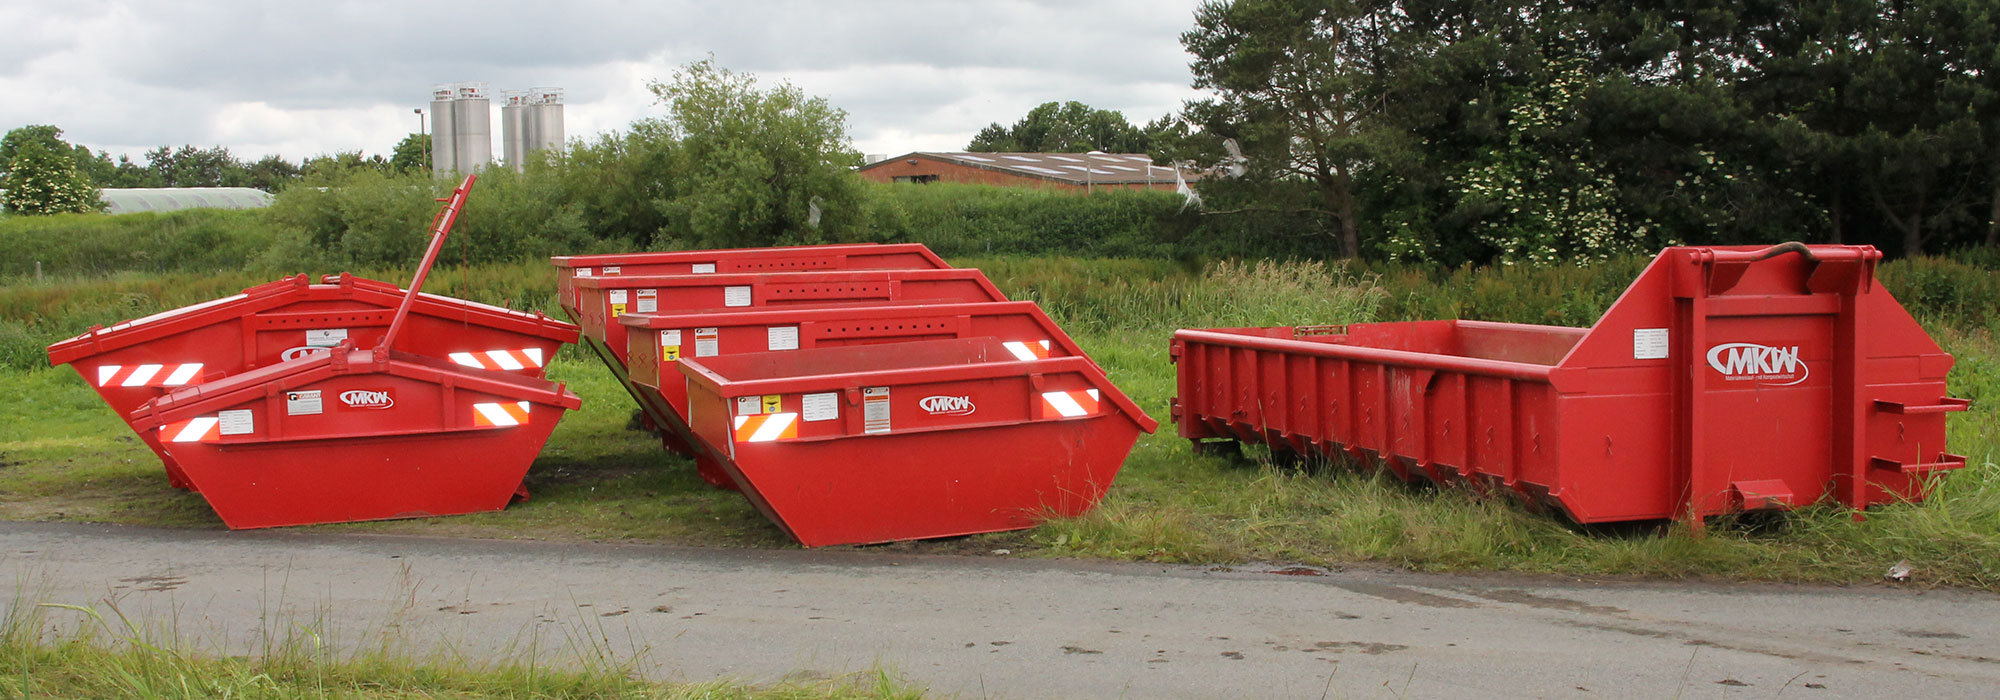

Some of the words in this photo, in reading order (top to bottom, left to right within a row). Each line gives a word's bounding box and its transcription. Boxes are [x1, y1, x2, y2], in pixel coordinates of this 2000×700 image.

[1725, 346, 1799, 375] MKW
[350, 391, 388, 405] MKW
[930, 396, 969, 412] MKW
